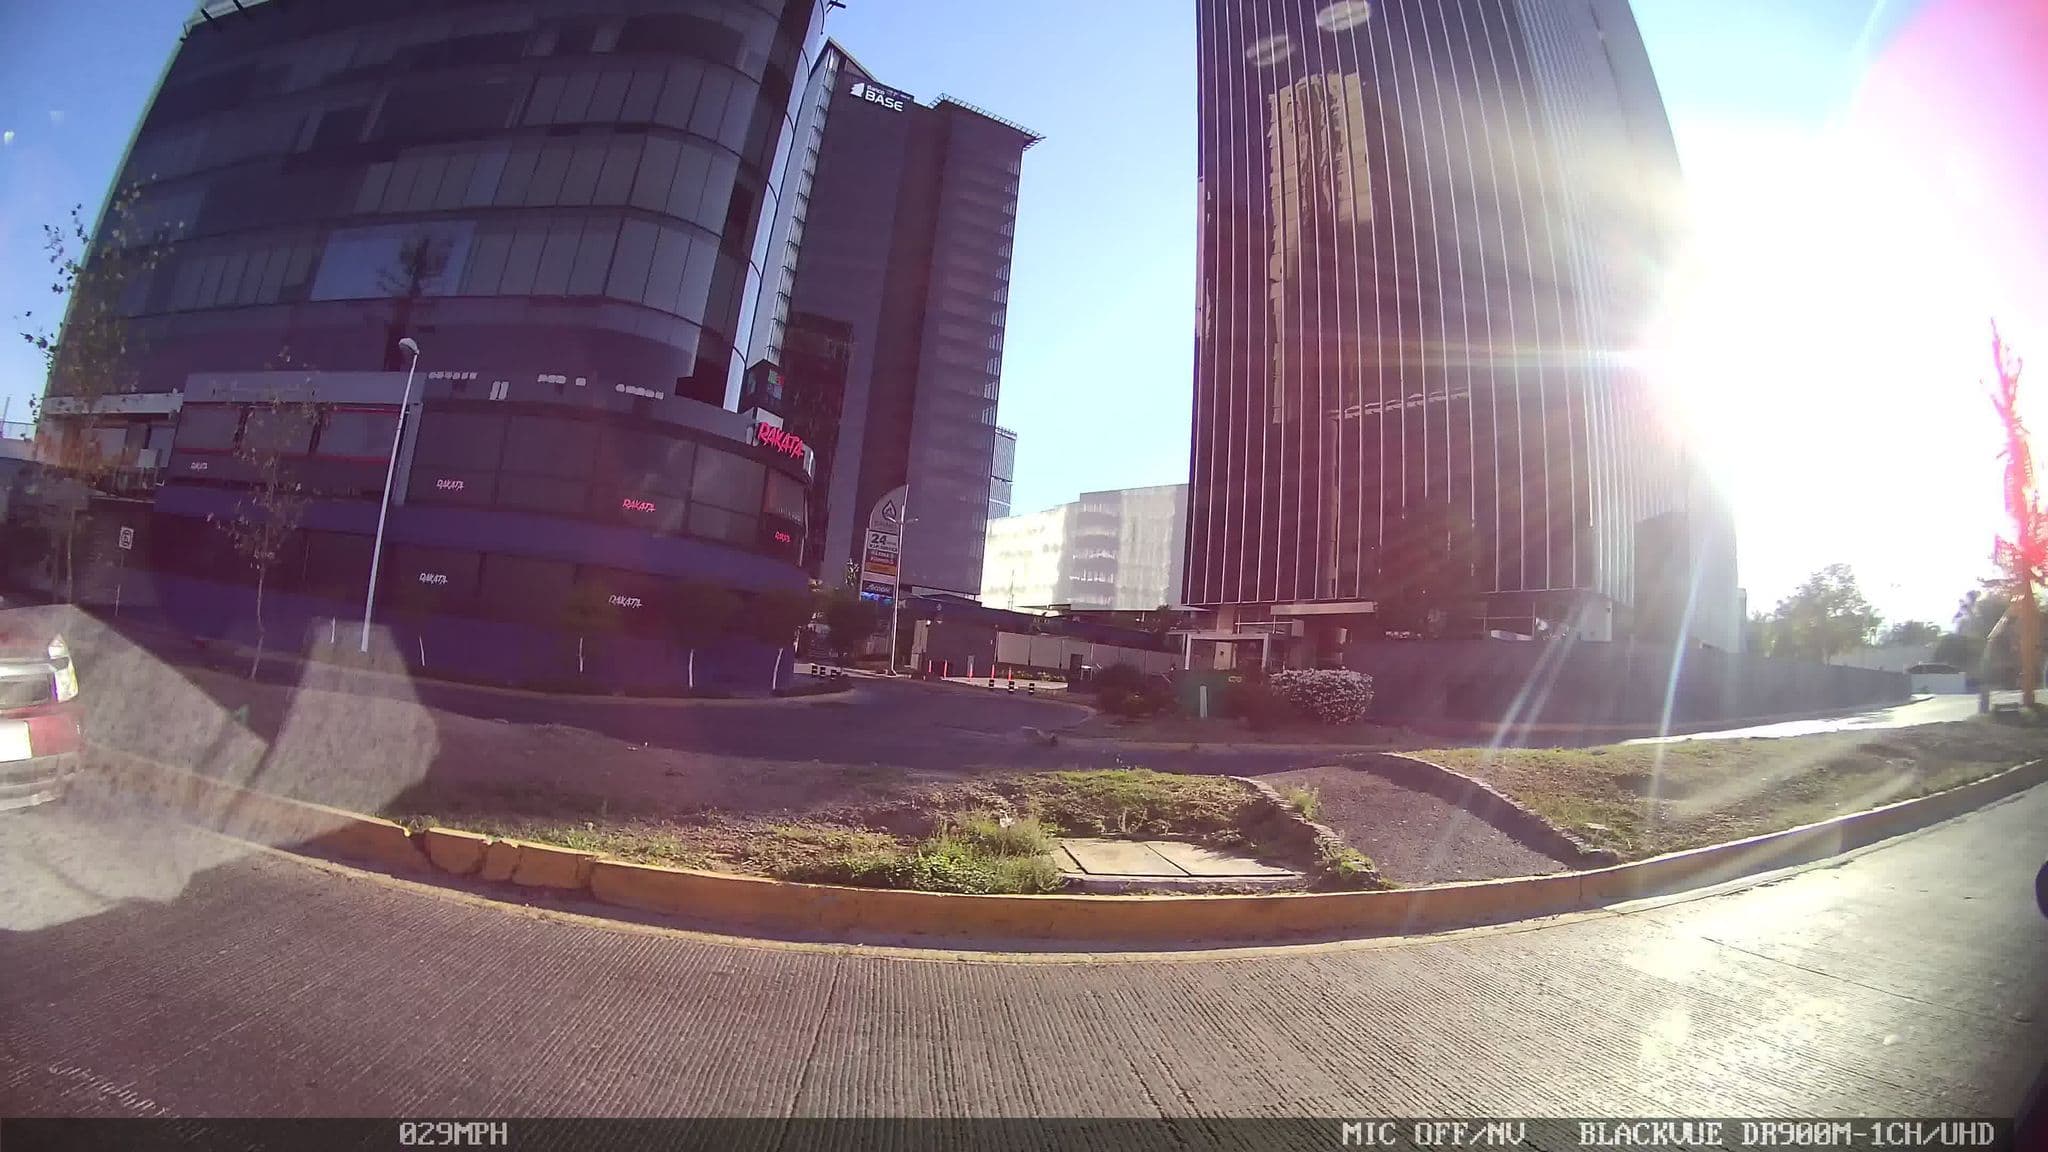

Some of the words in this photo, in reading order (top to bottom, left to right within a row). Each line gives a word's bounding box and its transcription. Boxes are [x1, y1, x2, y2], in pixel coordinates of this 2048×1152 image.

[864, 90, 904, 112] BASE
[758, 421, 804, 459] RAKATA
[622, 498, 657, 513] RAKATA
[871, 534, 887, 545] 24
